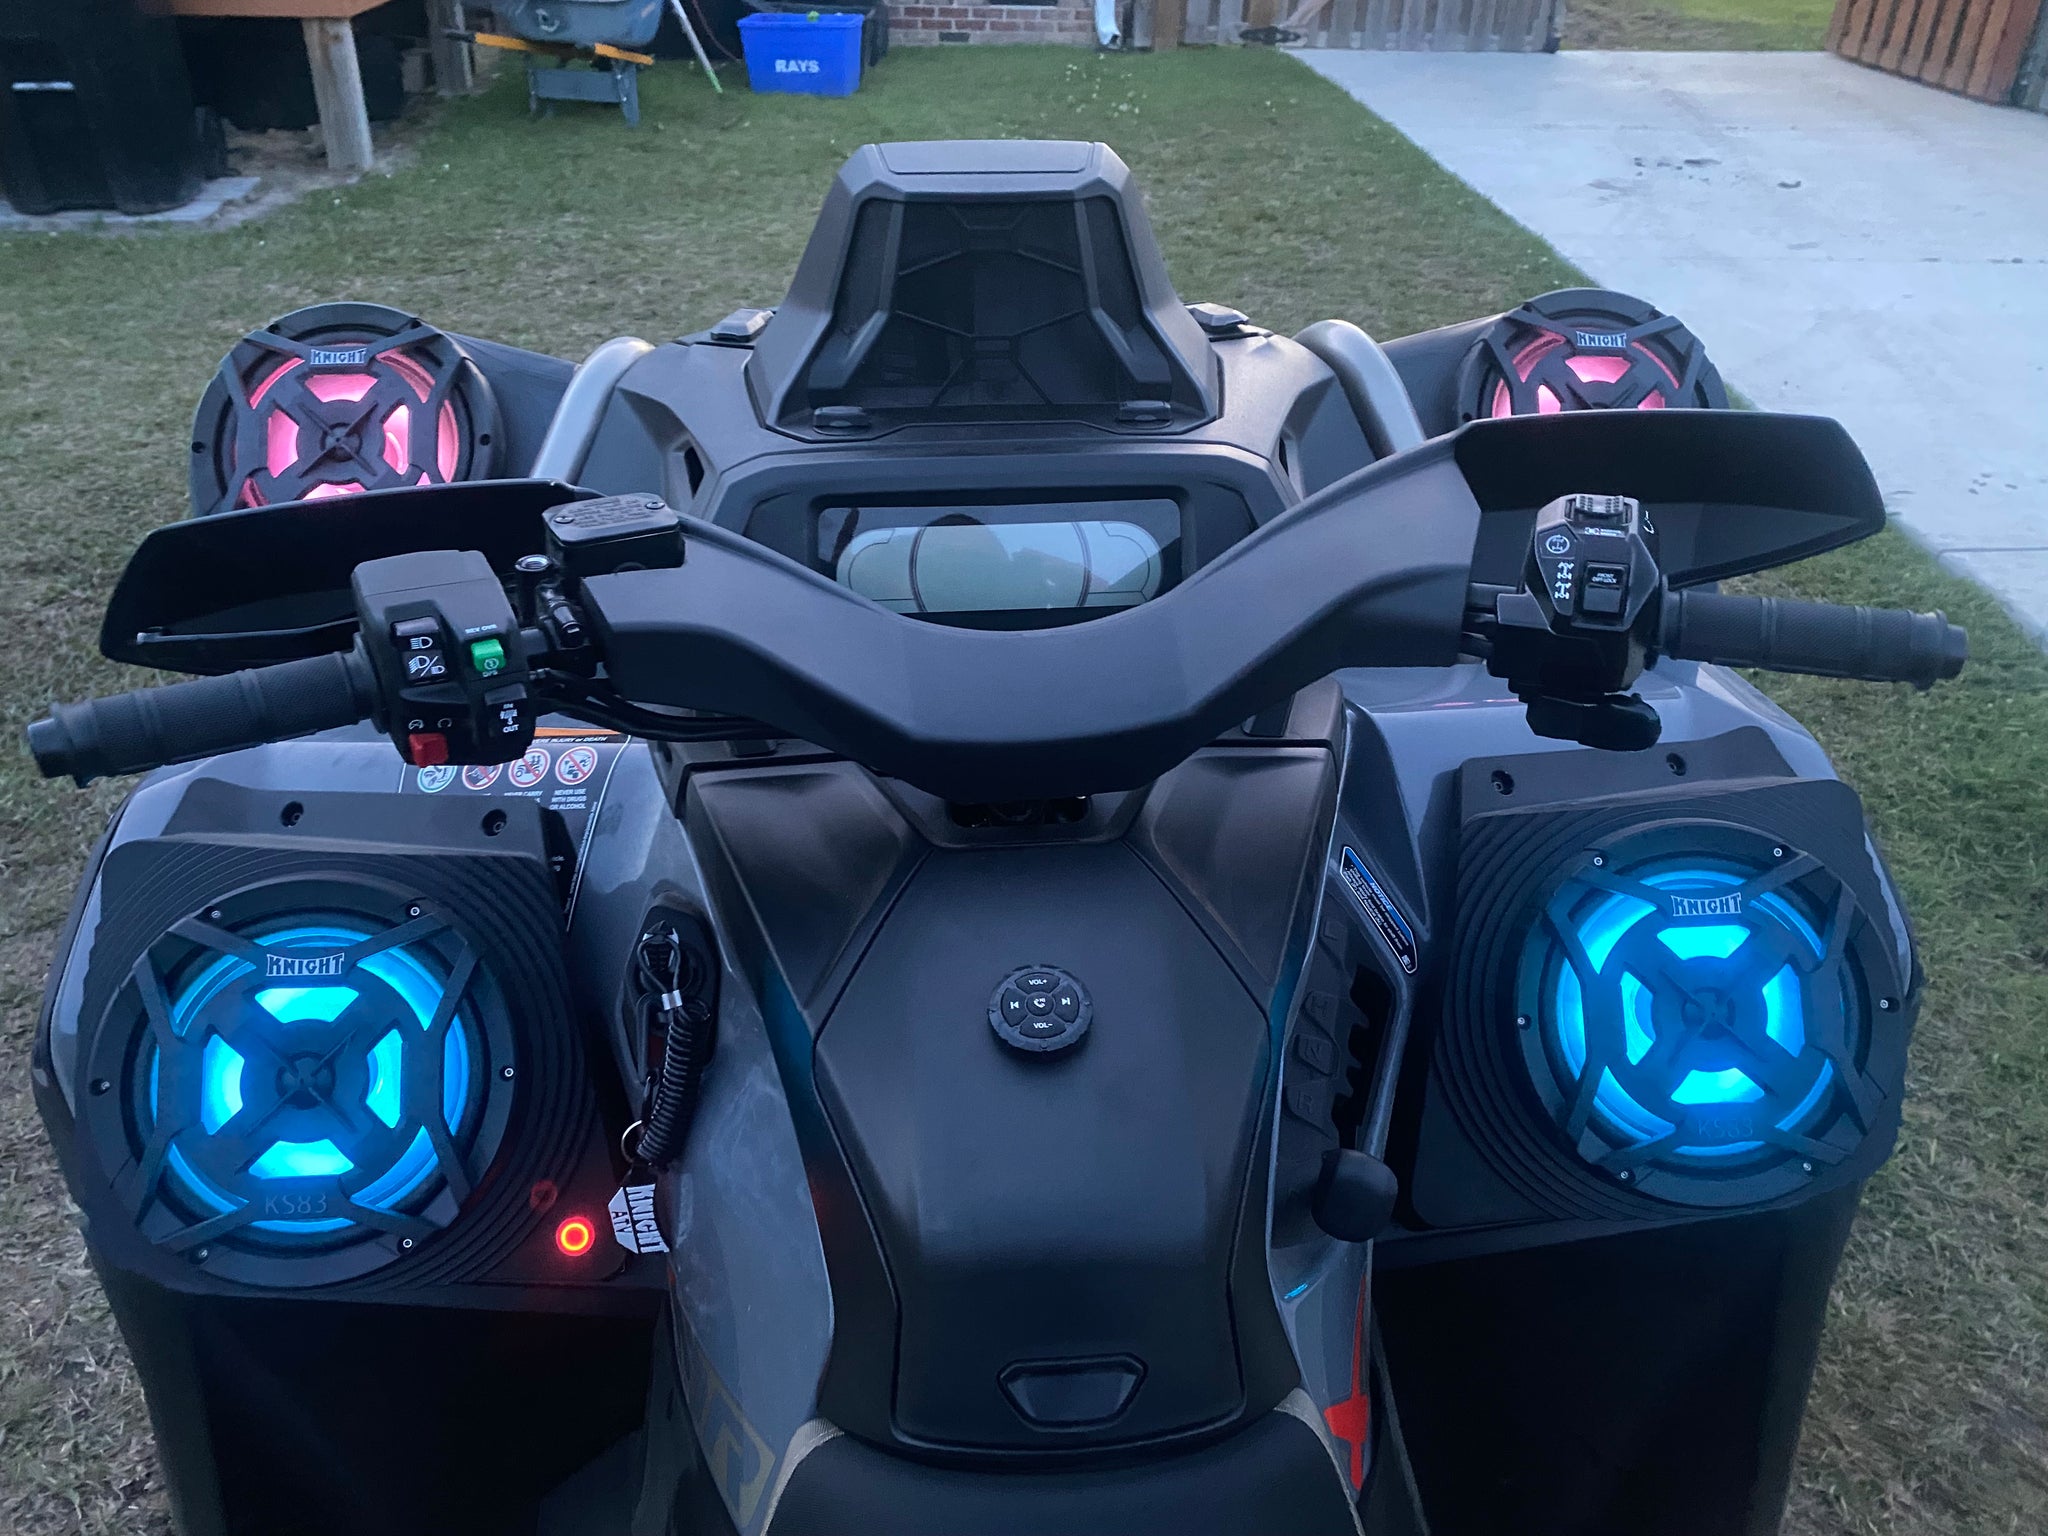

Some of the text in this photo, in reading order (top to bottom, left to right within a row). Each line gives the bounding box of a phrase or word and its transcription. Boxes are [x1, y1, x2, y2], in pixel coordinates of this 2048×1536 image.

[774, 58, 820, 73] RAYS
[1576, 331, 1627, 348] KNIGHT
[311, 348, 367, 364] KNIGHT
[502, 723, 520, 733] OUT
[1369, 882, 1393, 912] NOTICE
[1670, 892, 1742, 917] KNIGHT
[266, 952, 345, 977] KNIGHT
[1028, 978, 1048, 986] VOL+
[265, 1192, 328, 1215] KS83
[611, 1211, 633, 1234] ATV
[626, 1184, 670, 1253] KNIGHT
